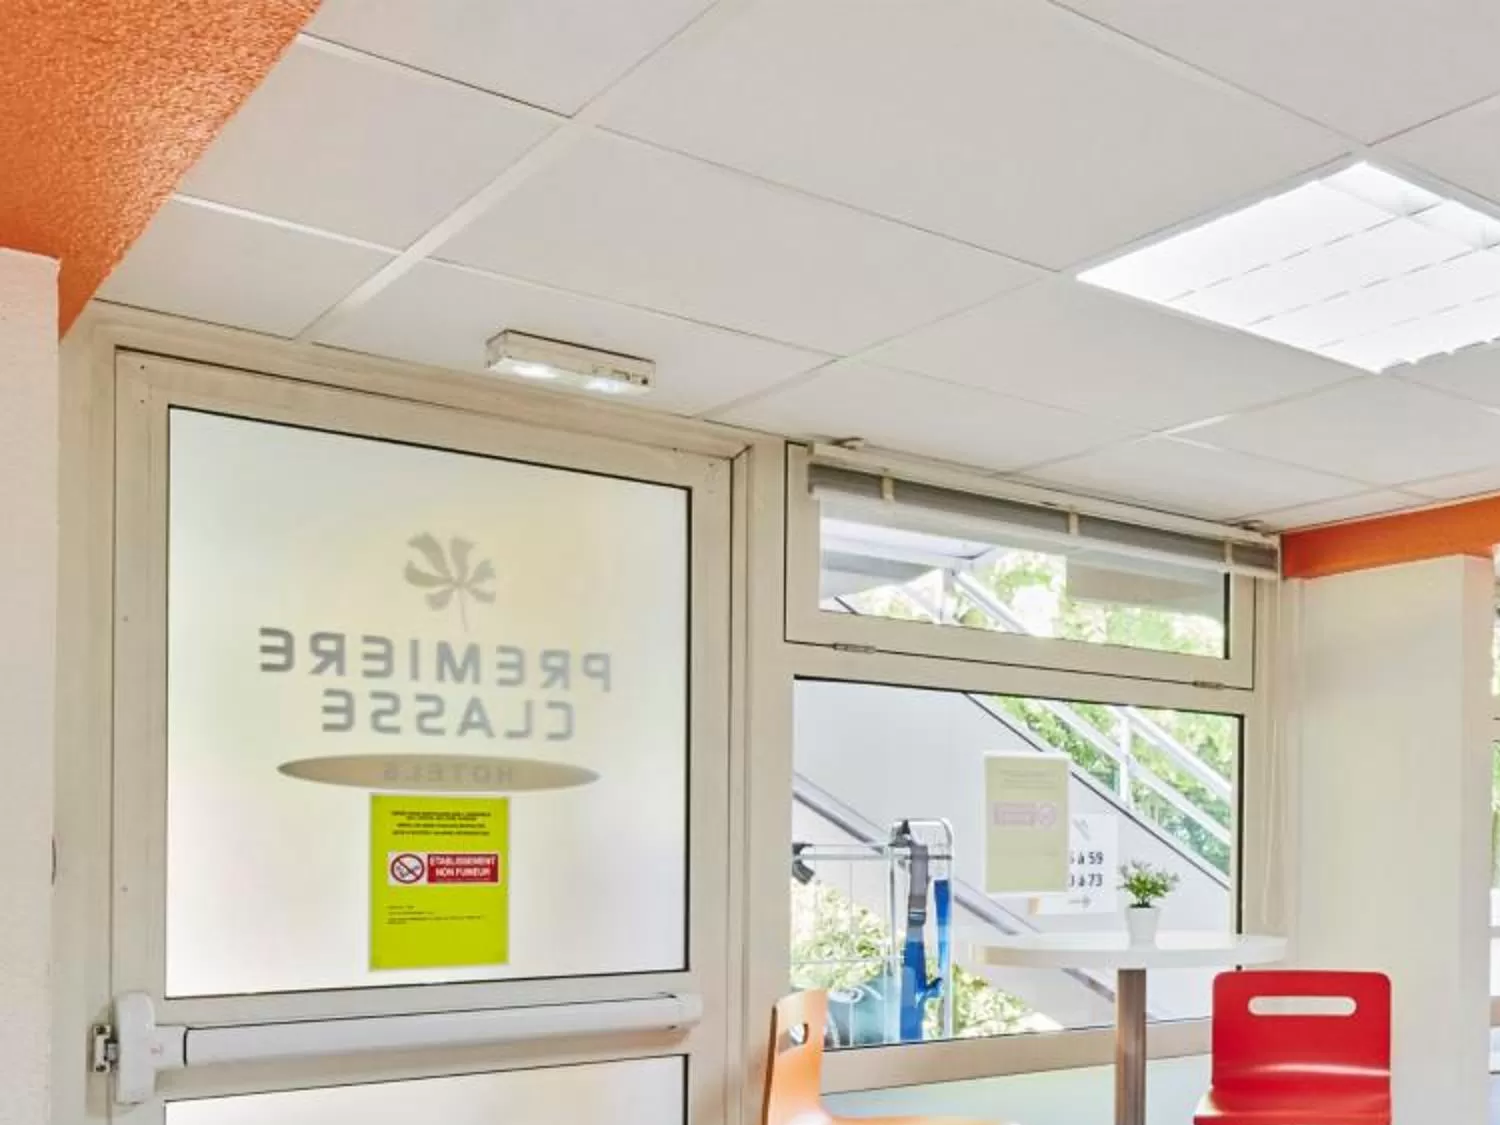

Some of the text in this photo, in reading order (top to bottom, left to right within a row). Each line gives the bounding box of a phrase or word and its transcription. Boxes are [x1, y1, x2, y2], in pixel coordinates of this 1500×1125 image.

[1088, 851, 1104, 865] 59
[435, 867, 455, 877] NON
[1088, 873, 1104, 887] 73
